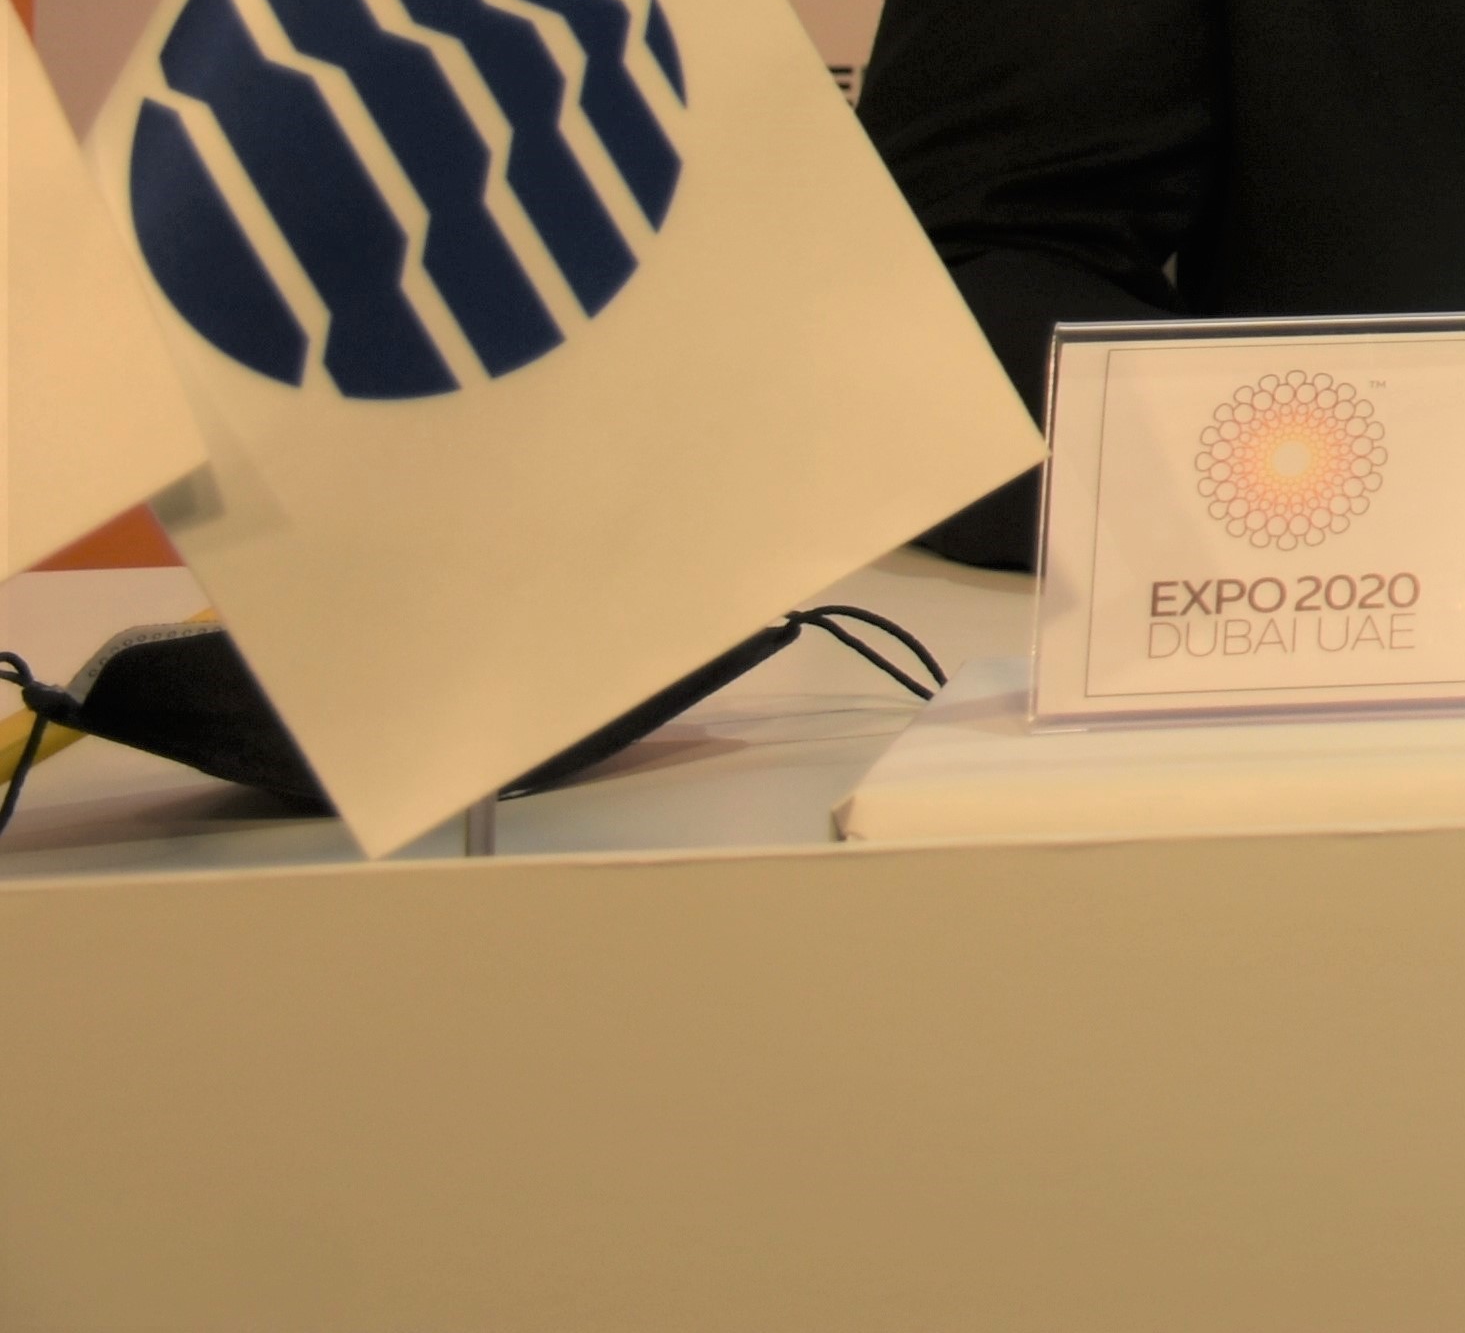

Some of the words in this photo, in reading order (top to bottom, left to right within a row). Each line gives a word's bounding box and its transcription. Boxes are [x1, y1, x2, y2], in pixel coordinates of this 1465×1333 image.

[1150, 577, 1285, 617] EXPO
[1294, 573, 1420, 612] 2020
[1146, 619, 1296, 659] DUBAI
[1317, 613, 1415, 652] UAE
